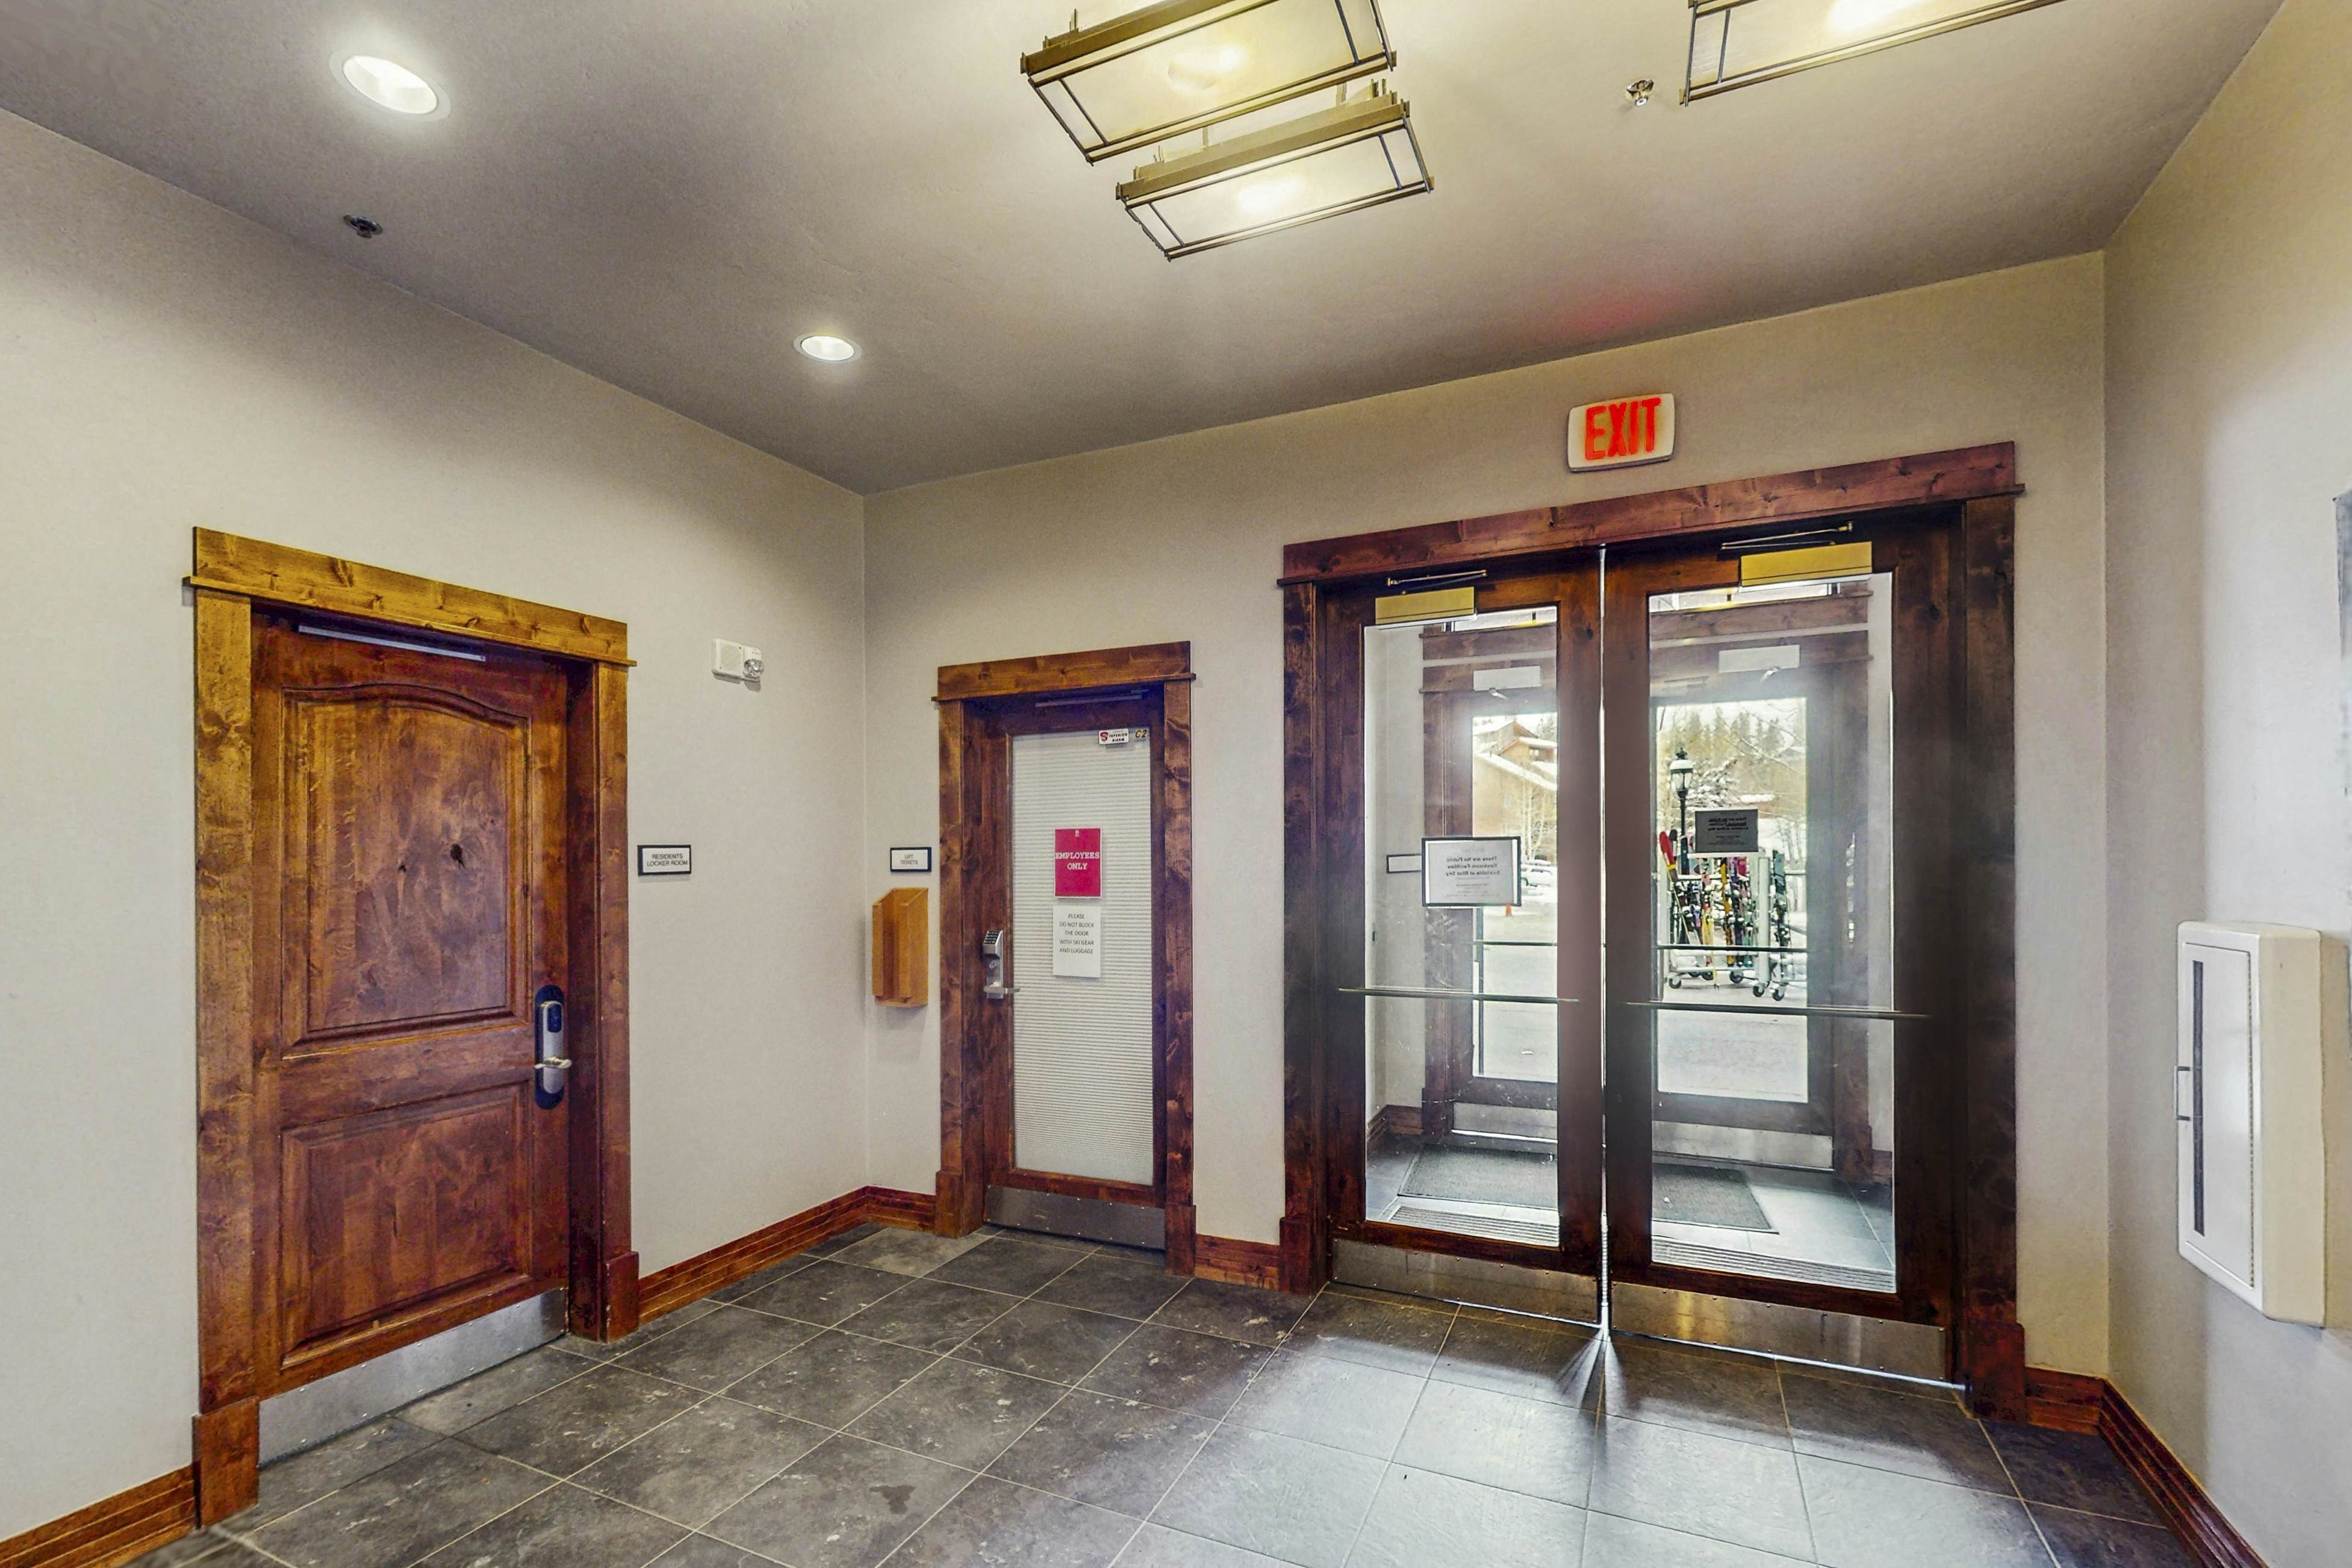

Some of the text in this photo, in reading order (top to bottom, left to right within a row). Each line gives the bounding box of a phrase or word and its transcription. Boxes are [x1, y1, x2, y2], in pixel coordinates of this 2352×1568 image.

[1585, 397, 1663, 461] EXIT
[1135, 730, 1147, 738] C2
[1055, 851, 1100, 860] EMPLOYEES
